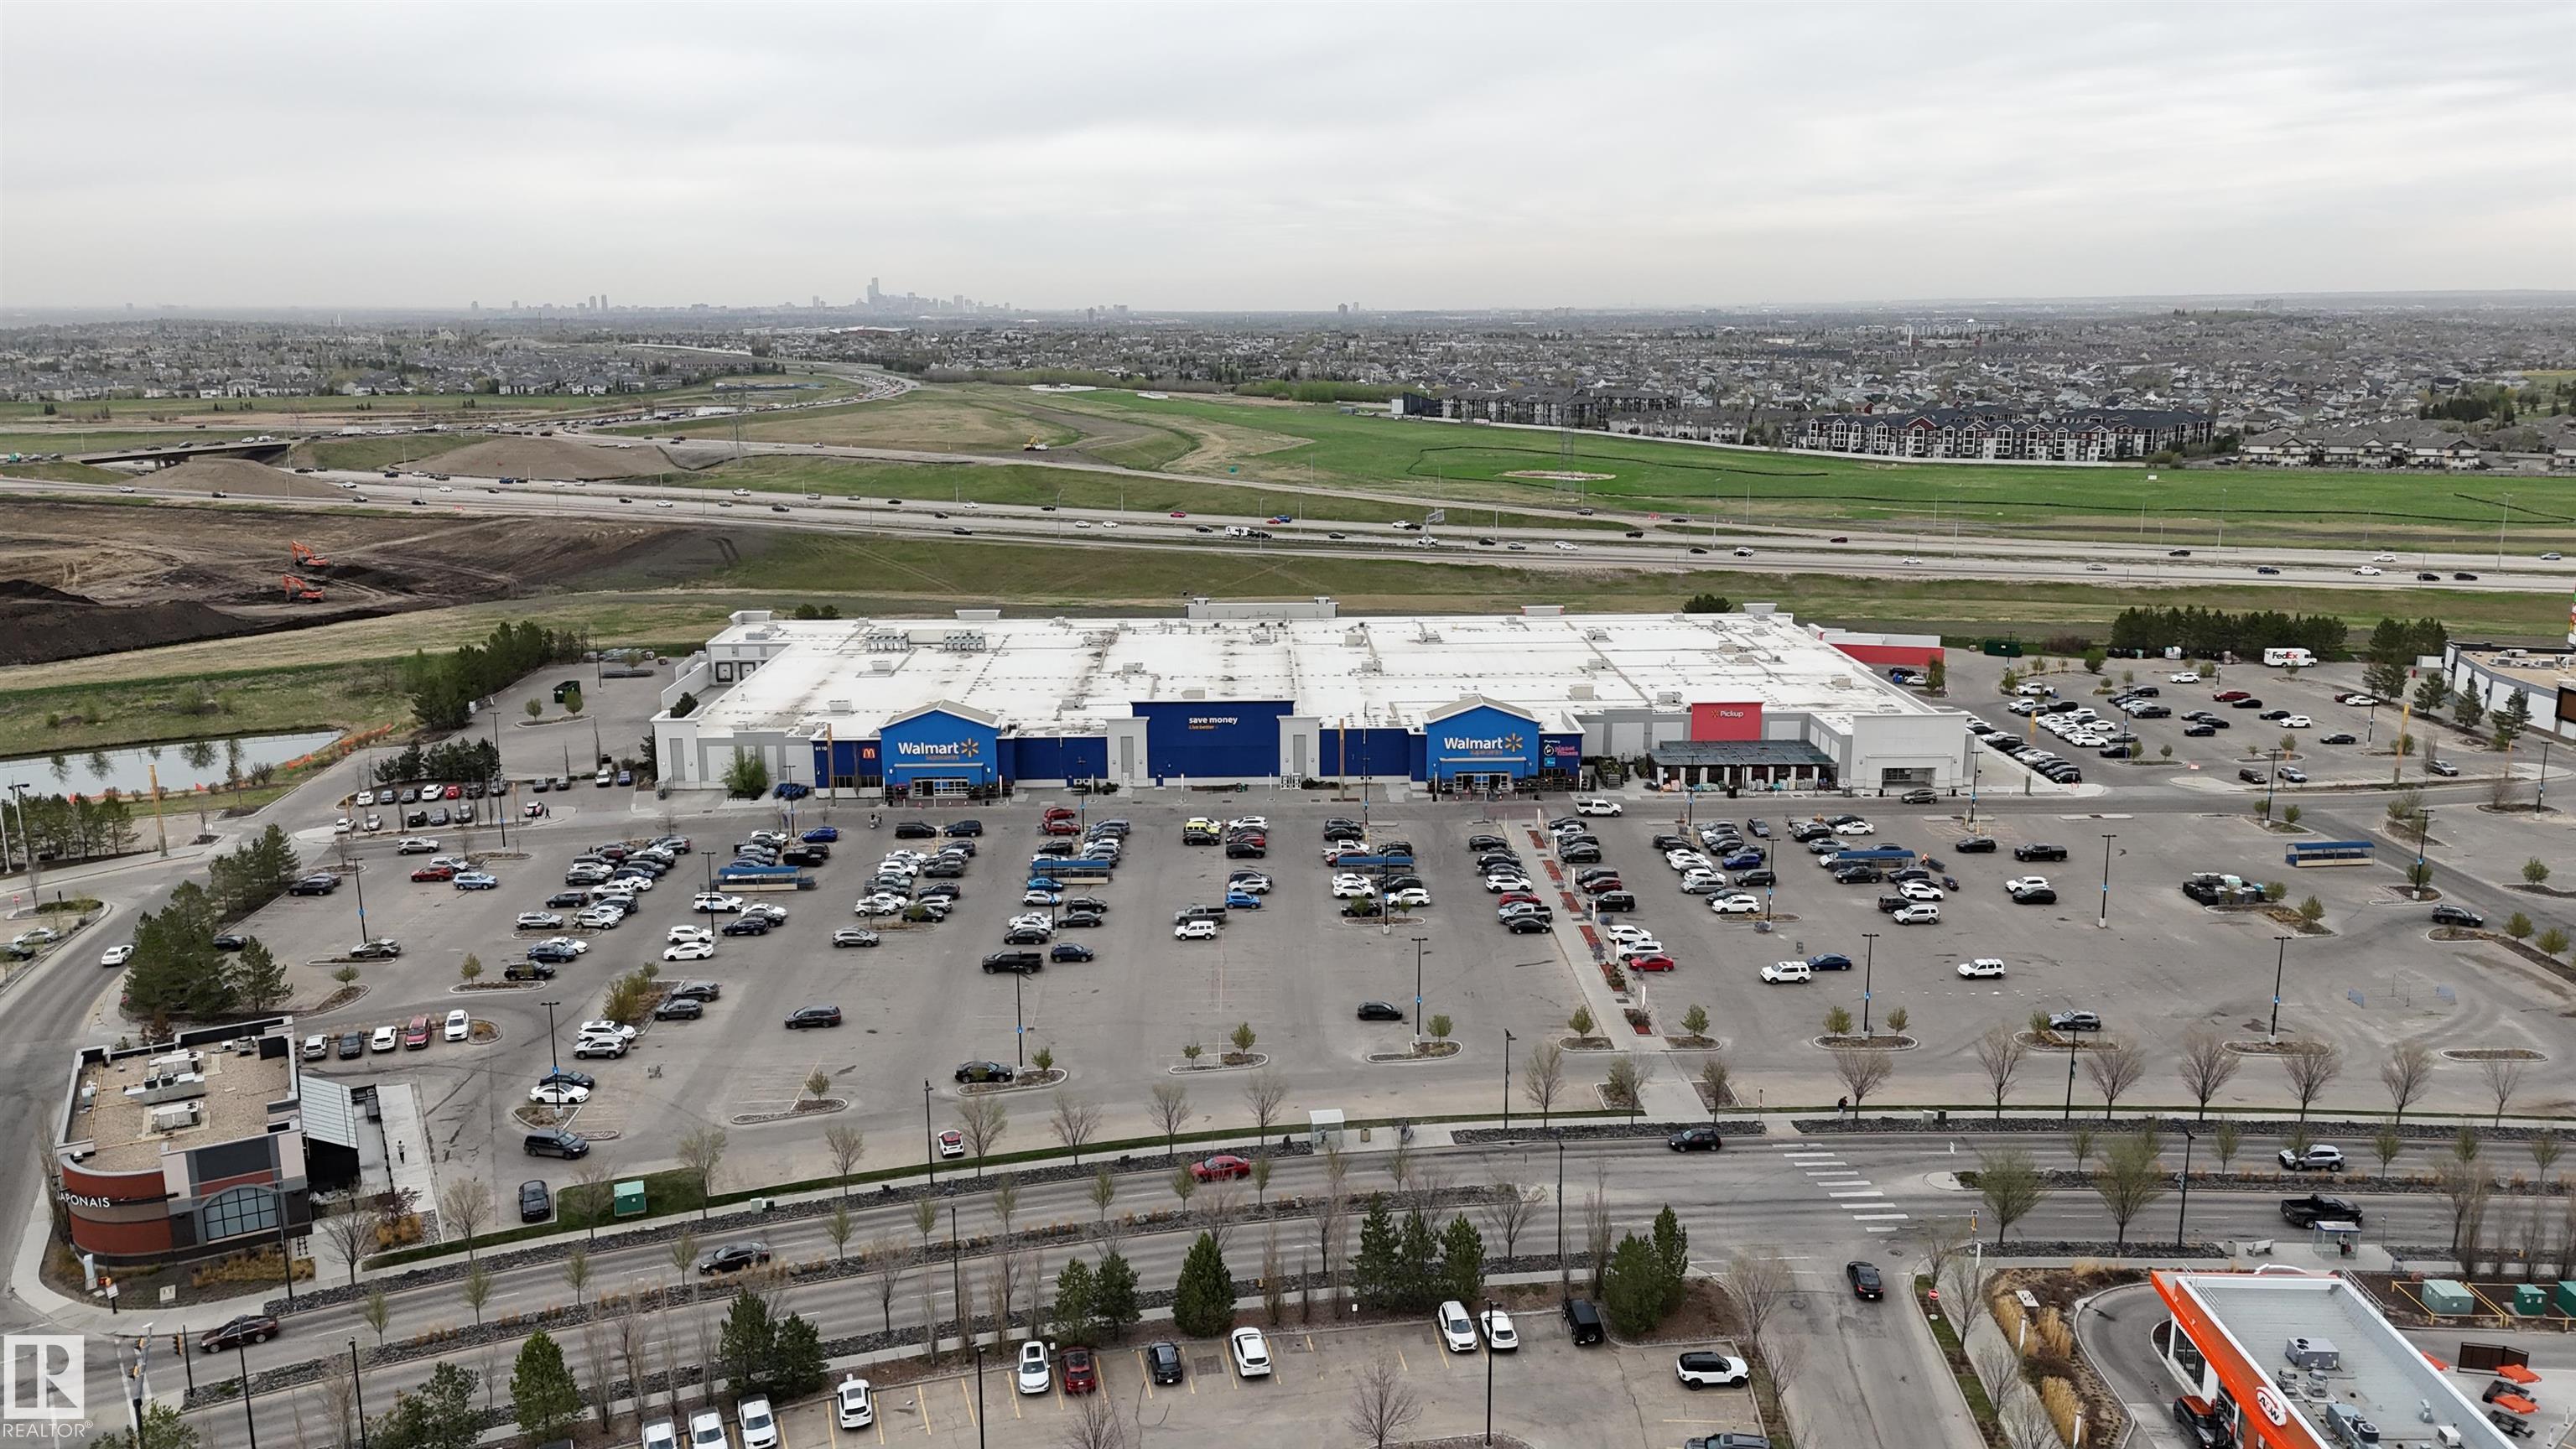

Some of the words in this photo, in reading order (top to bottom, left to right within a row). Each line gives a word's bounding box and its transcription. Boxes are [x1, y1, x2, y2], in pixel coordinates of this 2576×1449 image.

[2272, 651, 2298, 659] FedEx
[1720, 710, 1744, 719] Pickup
[1209, 717, 1238, 725] money
[898, 742, 959, 755] Walmart
[1444, 737, 1504, 750] Walmart
[2259, 1397, 2279, 1420] A&W
